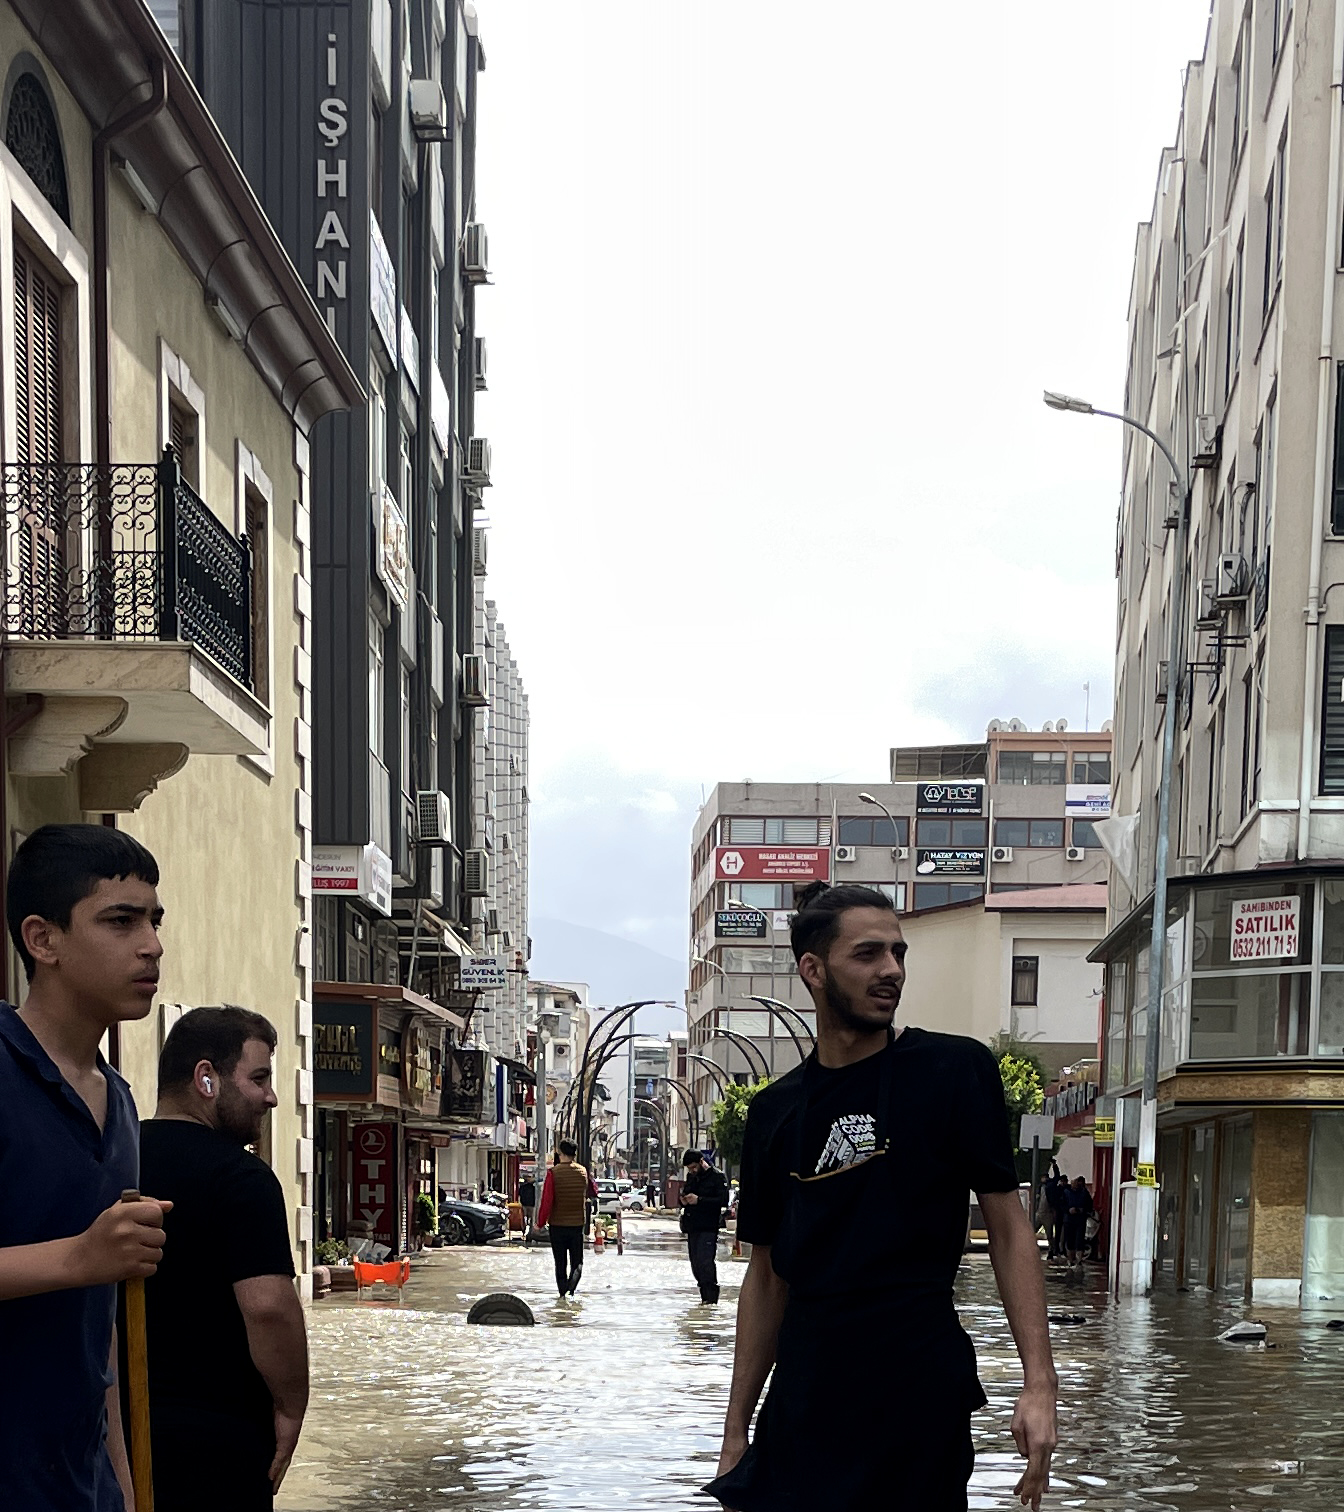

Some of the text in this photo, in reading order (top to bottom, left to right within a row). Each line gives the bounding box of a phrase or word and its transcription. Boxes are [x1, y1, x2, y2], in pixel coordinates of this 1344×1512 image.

[1241, 900, 1292, 913] SAHİBİNDEN
[1235, 914, 1296, 935] SATILIK
[1232, 935, 1297, 959] 0532 211 71 51
[461, 966, 505, 976] GÜVENLİK
[839, 1114, 876, 1125] ALPHA
[842, 1124, 875, 1134] CODE
[359, 1160, 386, 1229] THY
